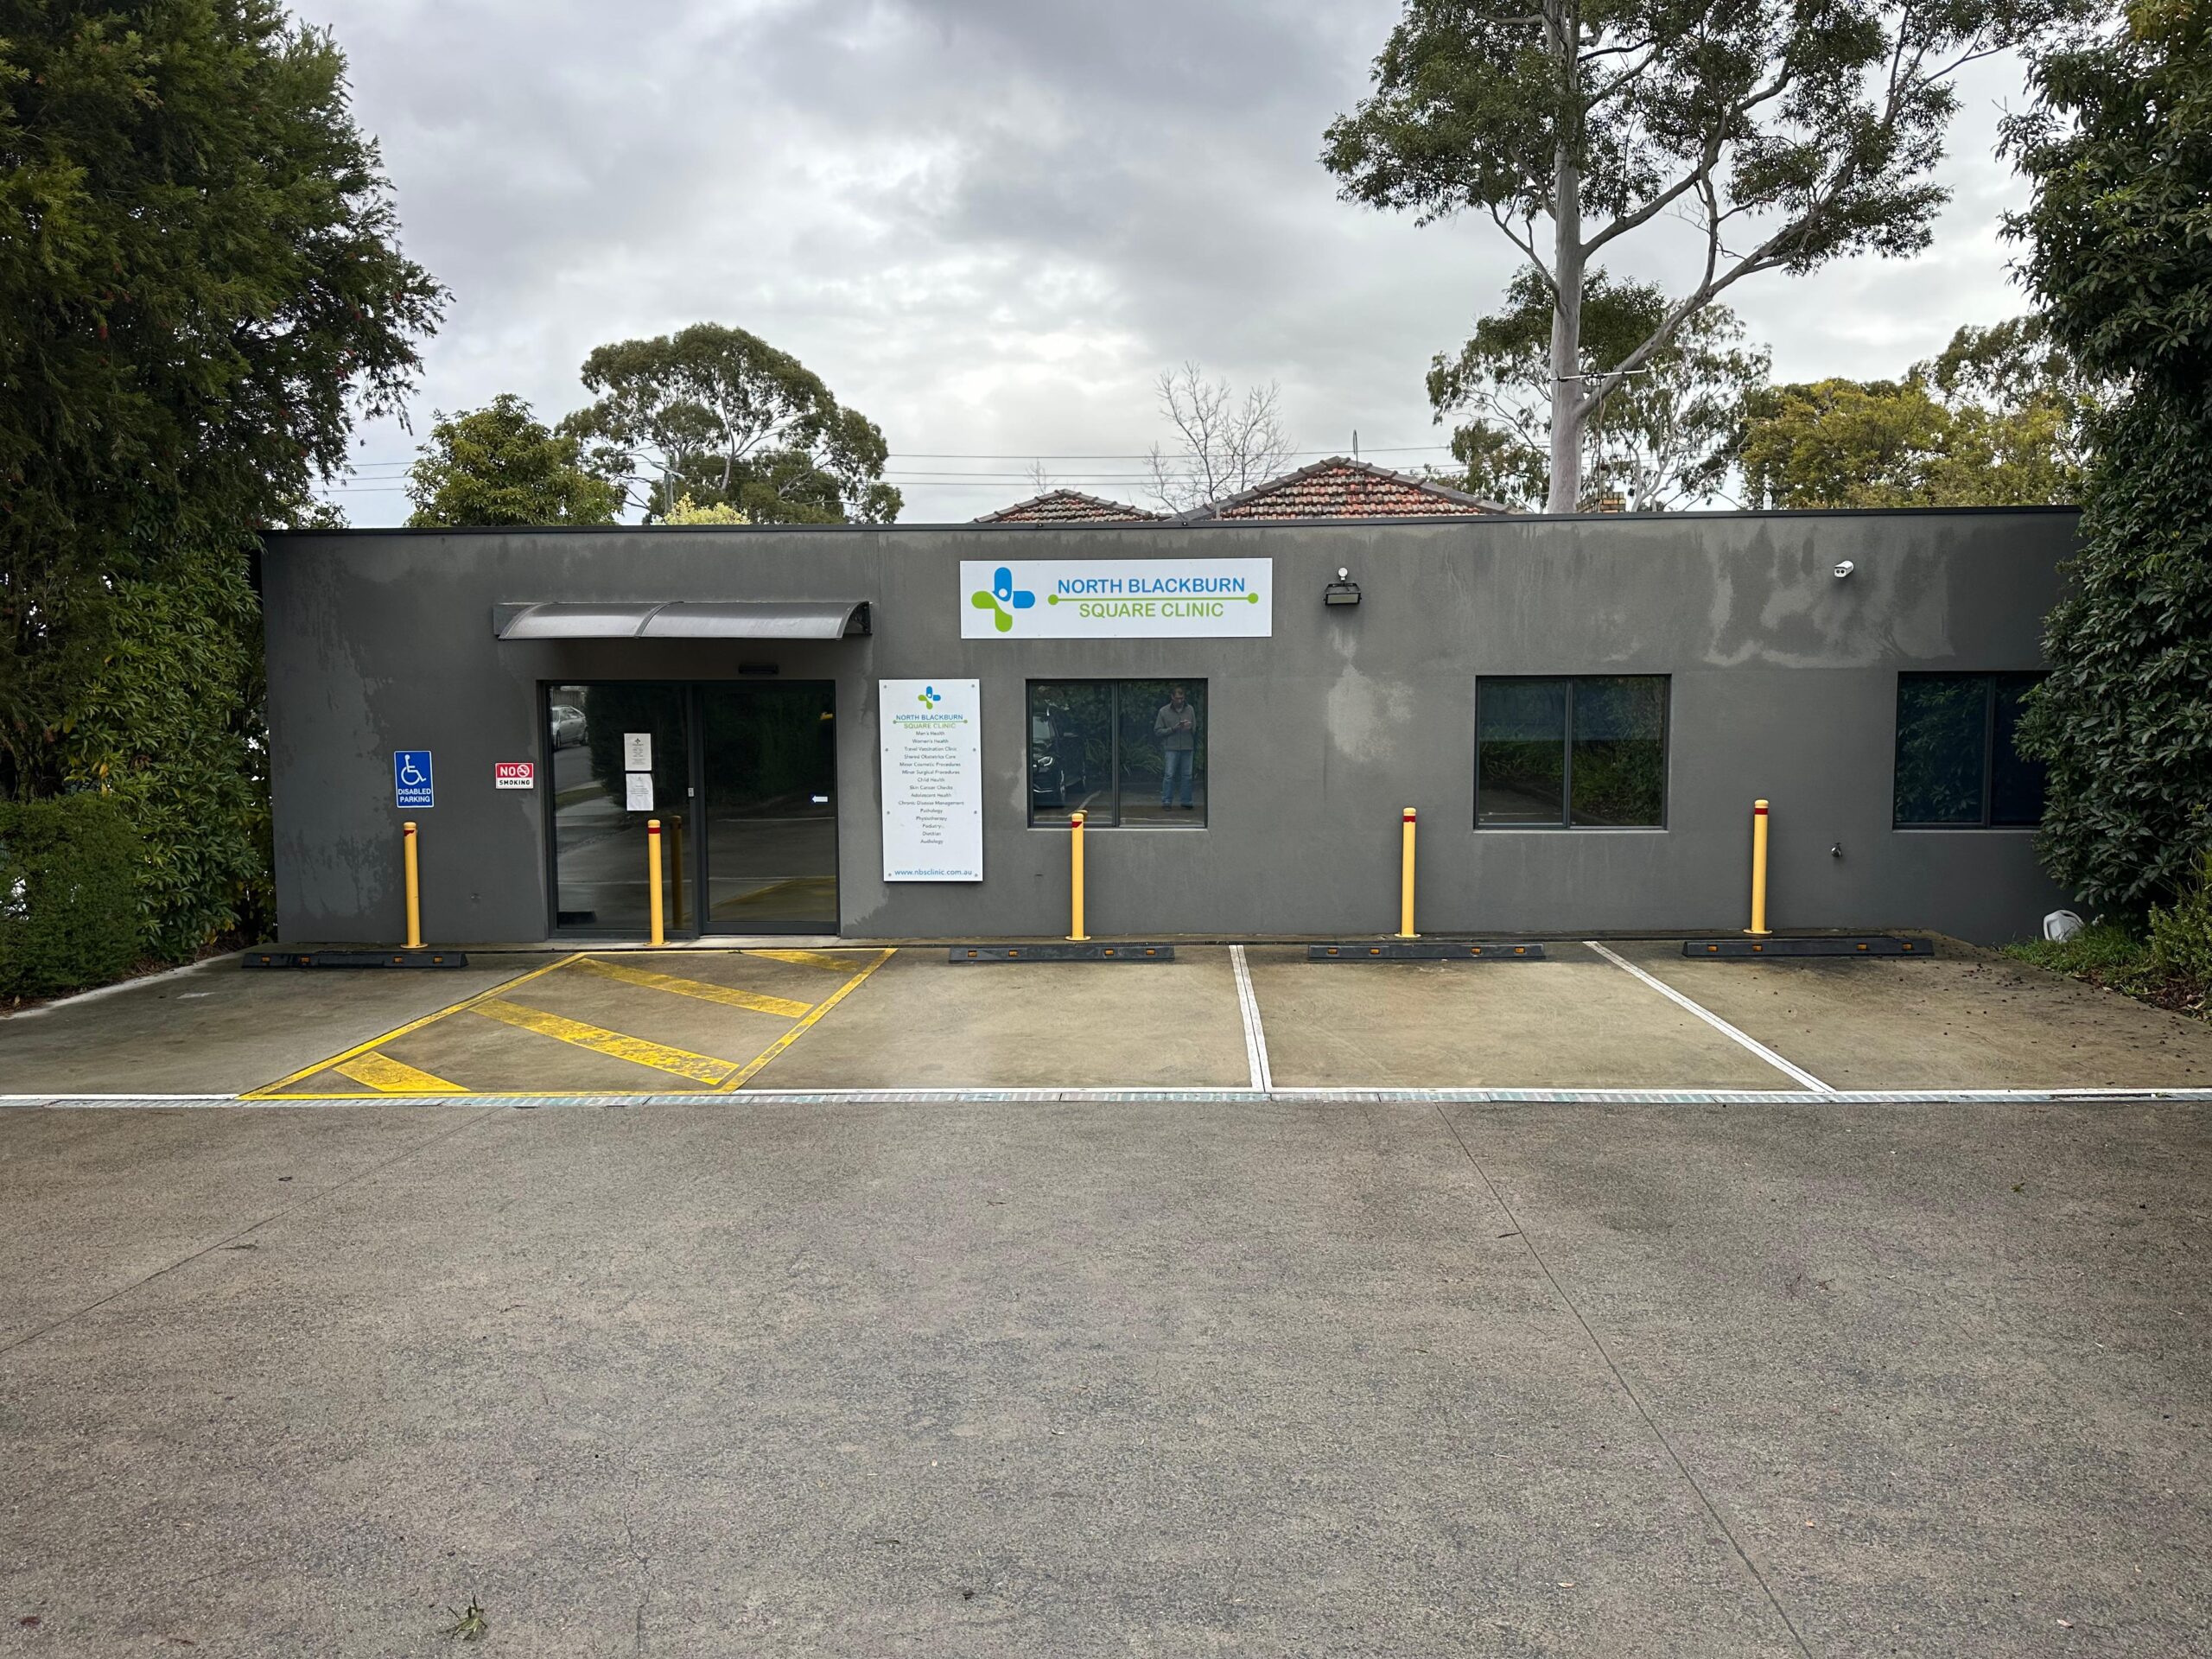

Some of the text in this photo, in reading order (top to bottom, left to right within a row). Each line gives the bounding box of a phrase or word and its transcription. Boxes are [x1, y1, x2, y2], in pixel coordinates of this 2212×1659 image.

[1058, 577, 1245, 594] NORTH BLACKBURN
[1079, 602, 1224, 618] SQUARE CLINIC
[500, 767, 516, 776] NO
